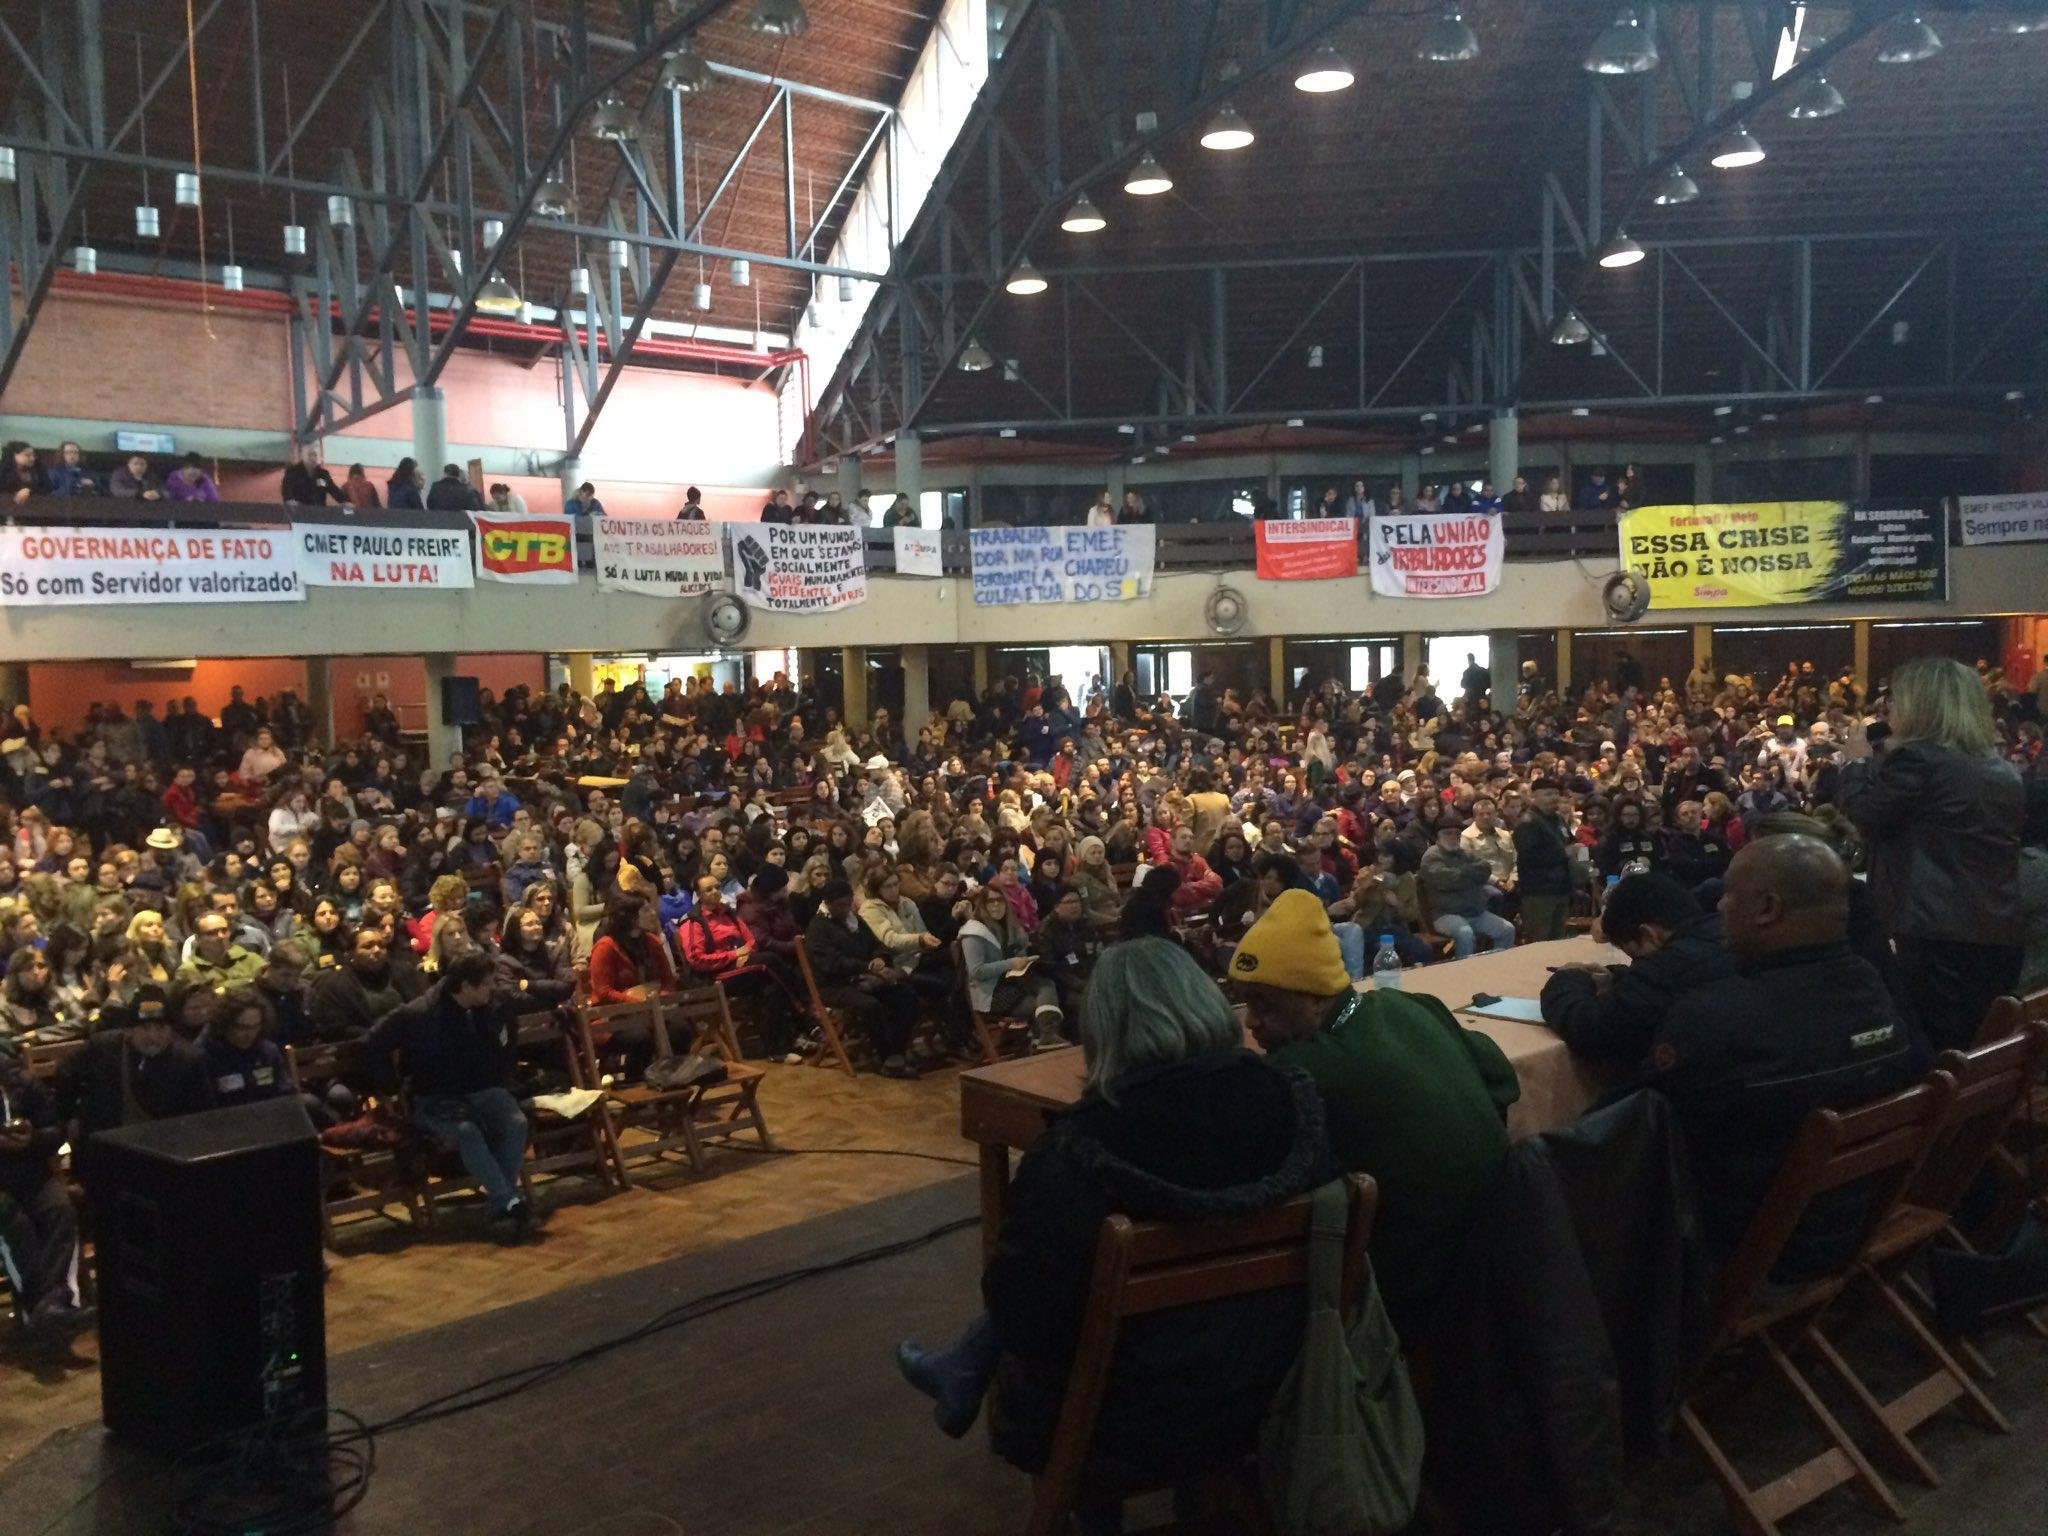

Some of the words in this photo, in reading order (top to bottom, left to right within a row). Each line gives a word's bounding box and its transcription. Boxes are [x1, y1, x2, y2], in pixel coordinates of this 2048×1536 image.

[1963, 502, 1989, 514] EMEF
[1991, 500, 2028, 512] HEITOR
[601, 519, 649, 535] CONTRA
[652, 522, 665, 536] OS
[667, 521, 711, 536] ATAQUES
[769, 527, 797, 544] POR
[799, 531, 817, 545] UM
[819, 530, 855, 545] MUNDO
[1268, 520, 1351, 535] INTERSINDICAL
[1381, 523, 1432, 545] PELA
[1433, 516, 1490, 544] UNIÃO
[1964, 519, 2029, 537] Sempre
[304, 533, 348, 555] CMET
[353, 535, 403, 556] PAULO
[407, 538, 461, 558] FREIRE
[484, 529, 567, 564] CTB
[625, 540, 718, 556] TRABALHADORES!
[1067, 528, 1127, 552] EMEF
[1630, 532, 1710, 555] ESSA
[1718, 525, 1809, 549] CRISE
[22, 536, 181, 566] GOVERNANÇA
[187, 538, 215, 559] DE
[221, 538, 273, 560] FATO
[771, 546, 789, 559] EM
[791, 547, 816, 560] QUE
[974, 549, 1009, 567] DOR
[330, 562, 365, 582] NA
[372, 563, 438, 583] LUTA!
[604, 564, 618, 579] SÓ
[621, 568, 629, 580] A
[634, 568, 661, 581] LUTA
[665, 570, 689, 582] MUDA
[693, 571, 700, 582] A
[773, 559, 850, 574] SOCIALMENTE
[1630, 556, 1689, 580] NÃO
[1696, 554, 1714, 576] É
[1720, 551, 1813, 575] NOSSA
[1, 570, 29, 595] Só
[37, 577, 84, 595] com
[91, 571, 183, 595] Servidor
[188, 570, 299, 593] valorizado!
[768, 571, 801, 586] IGUAIS
[769, 585, 832, 598] DIFERENTES
[766, 597, 830, 609] TOTALMENTE
